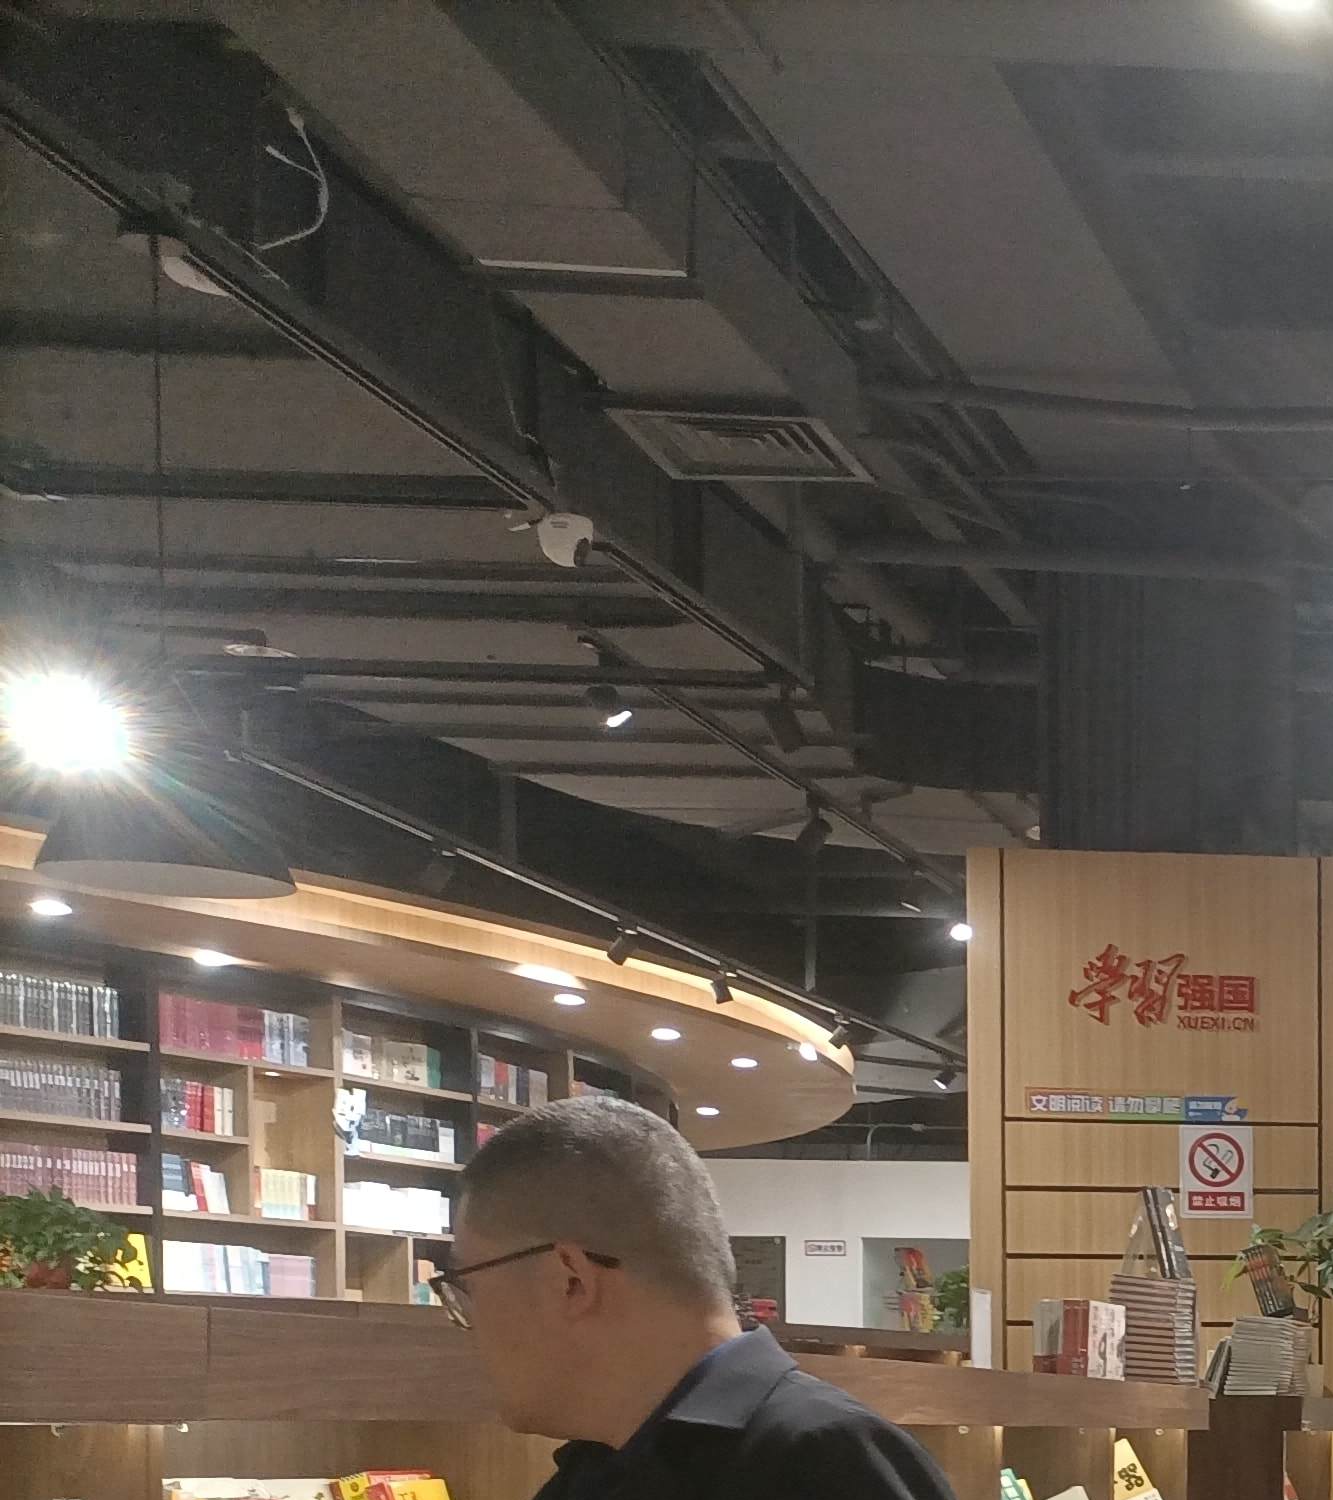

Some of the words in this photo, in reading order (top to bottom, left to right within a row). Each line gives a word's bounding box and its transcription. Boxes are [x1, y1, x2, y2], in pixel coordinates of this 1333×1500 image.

[1177, 1015, 1256, 1032] XUEXI.CN
[1030, 1094, 1104, 1113] 文明阅读
[1191, 1195, 1243, 1208] 禁止吸烟
